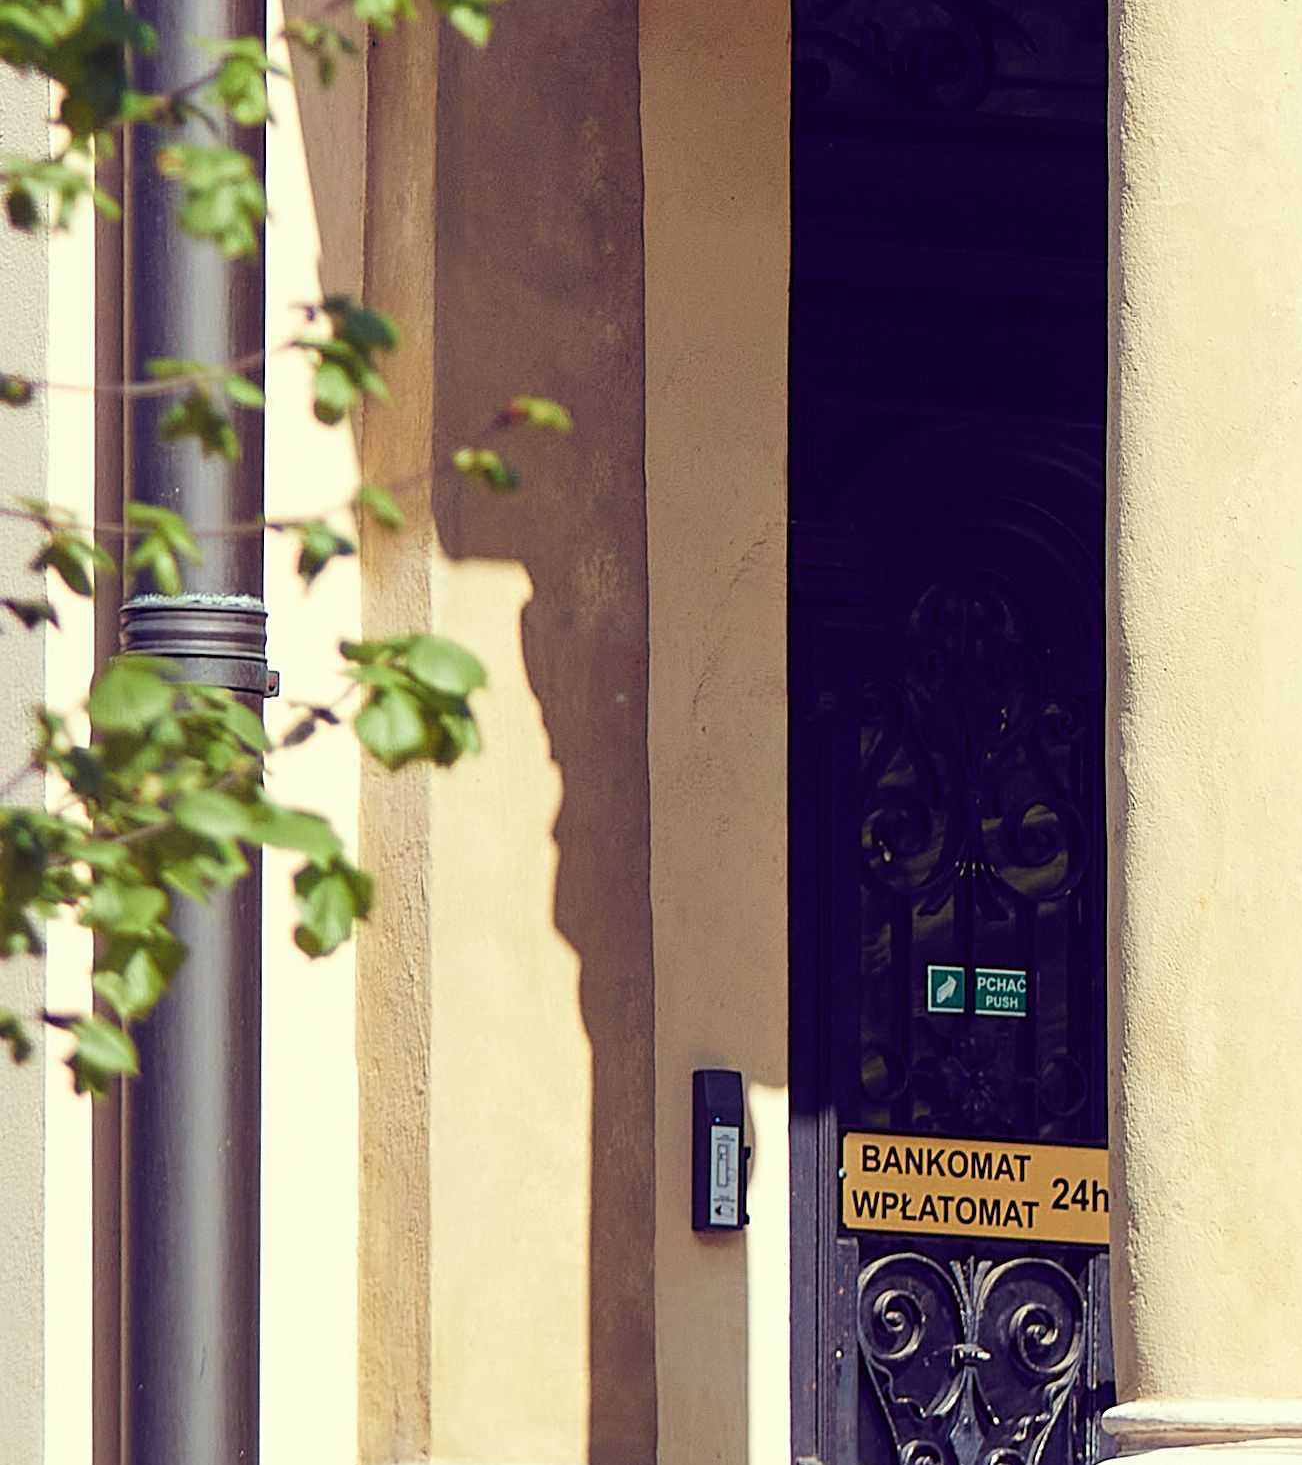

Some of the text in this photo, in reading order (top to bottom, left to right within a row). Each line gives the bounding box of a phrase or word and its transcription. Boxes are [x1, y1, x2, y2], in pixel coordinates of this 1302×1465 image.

[977, 976, 1026, 993] PCHAĆ
[986, 995, 1018, 1009] PUSH
[862, 1145, 1031, 1182] BANKOMAT
[852, 1190, 1039, 1229] WPŁATOMAT
[1052, 1178, 1109, 1212] 24h
